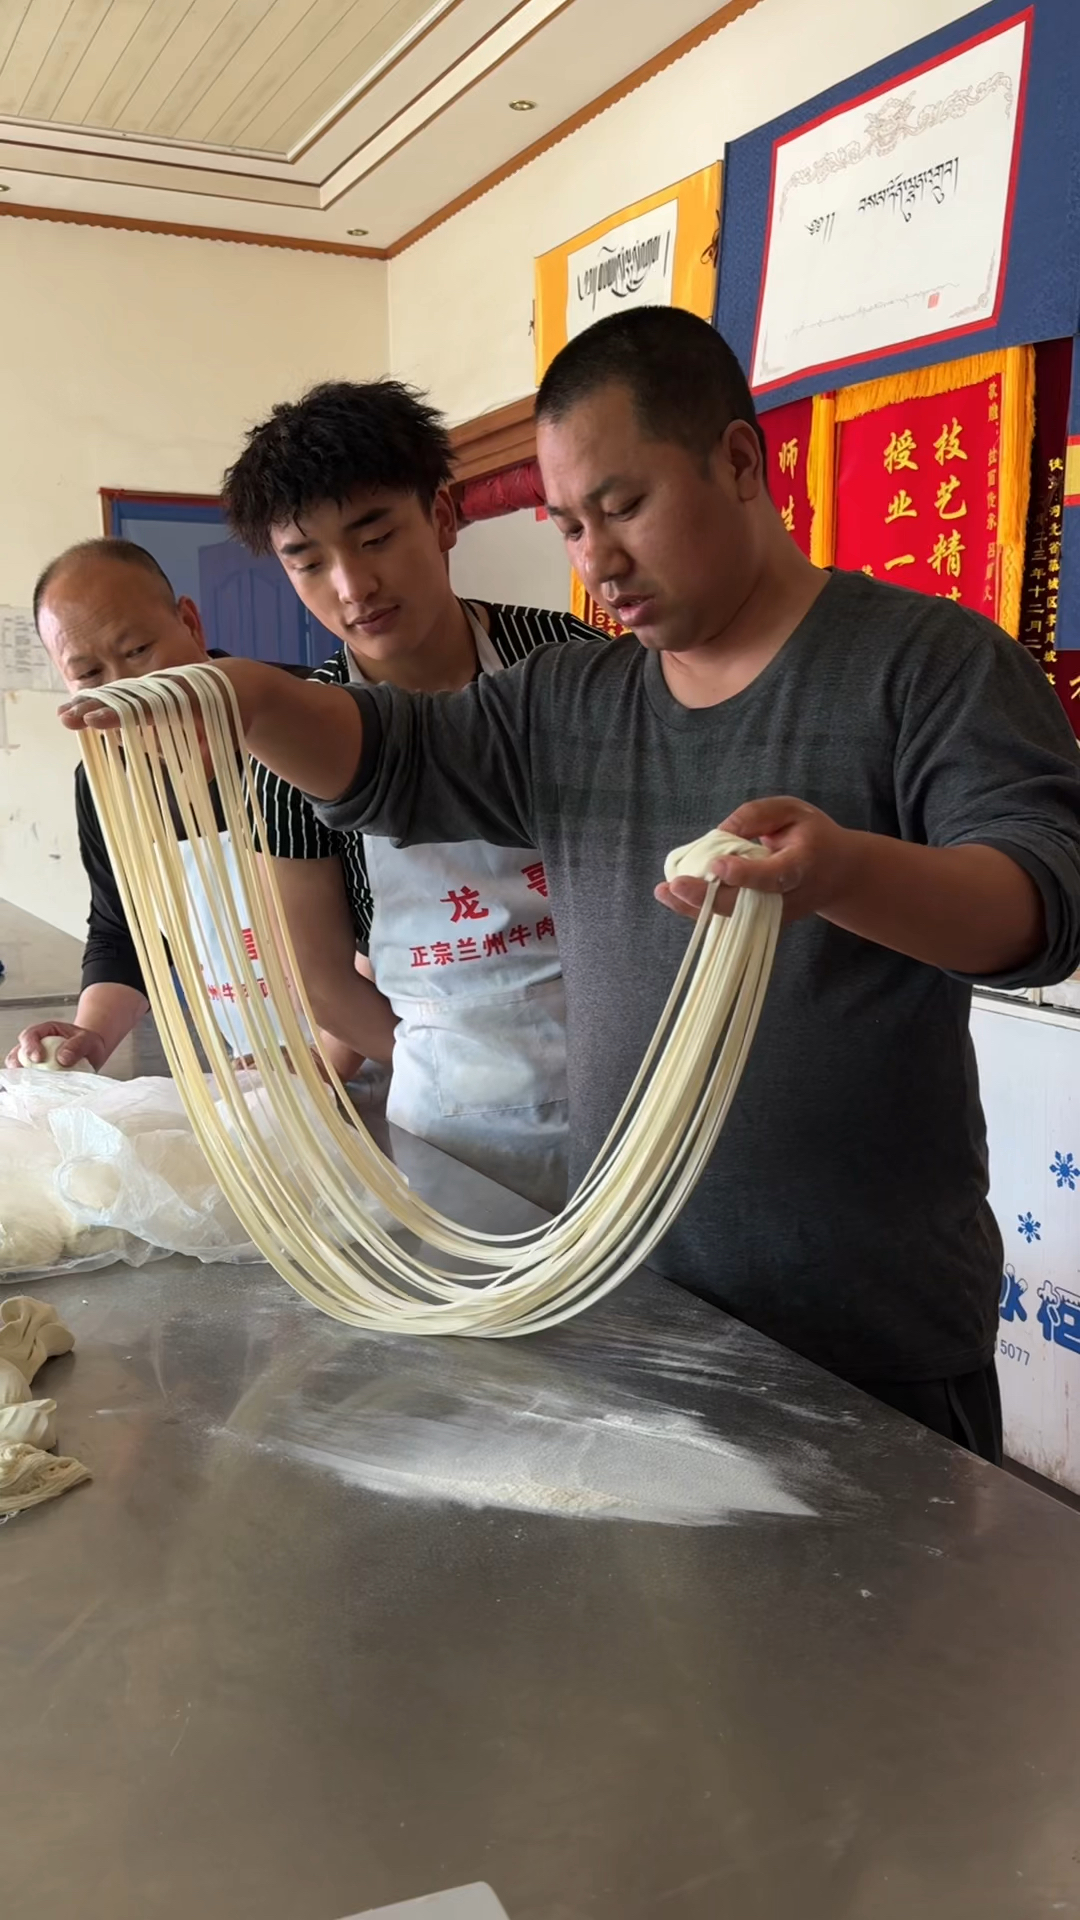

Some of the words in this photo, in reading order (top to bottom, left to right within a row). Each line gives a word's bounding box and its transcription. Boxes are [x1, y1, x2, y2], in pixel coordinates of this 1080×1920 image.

[883, 428, 919, 571] 授业一
[927, 417, 968, 603] 技艺精
